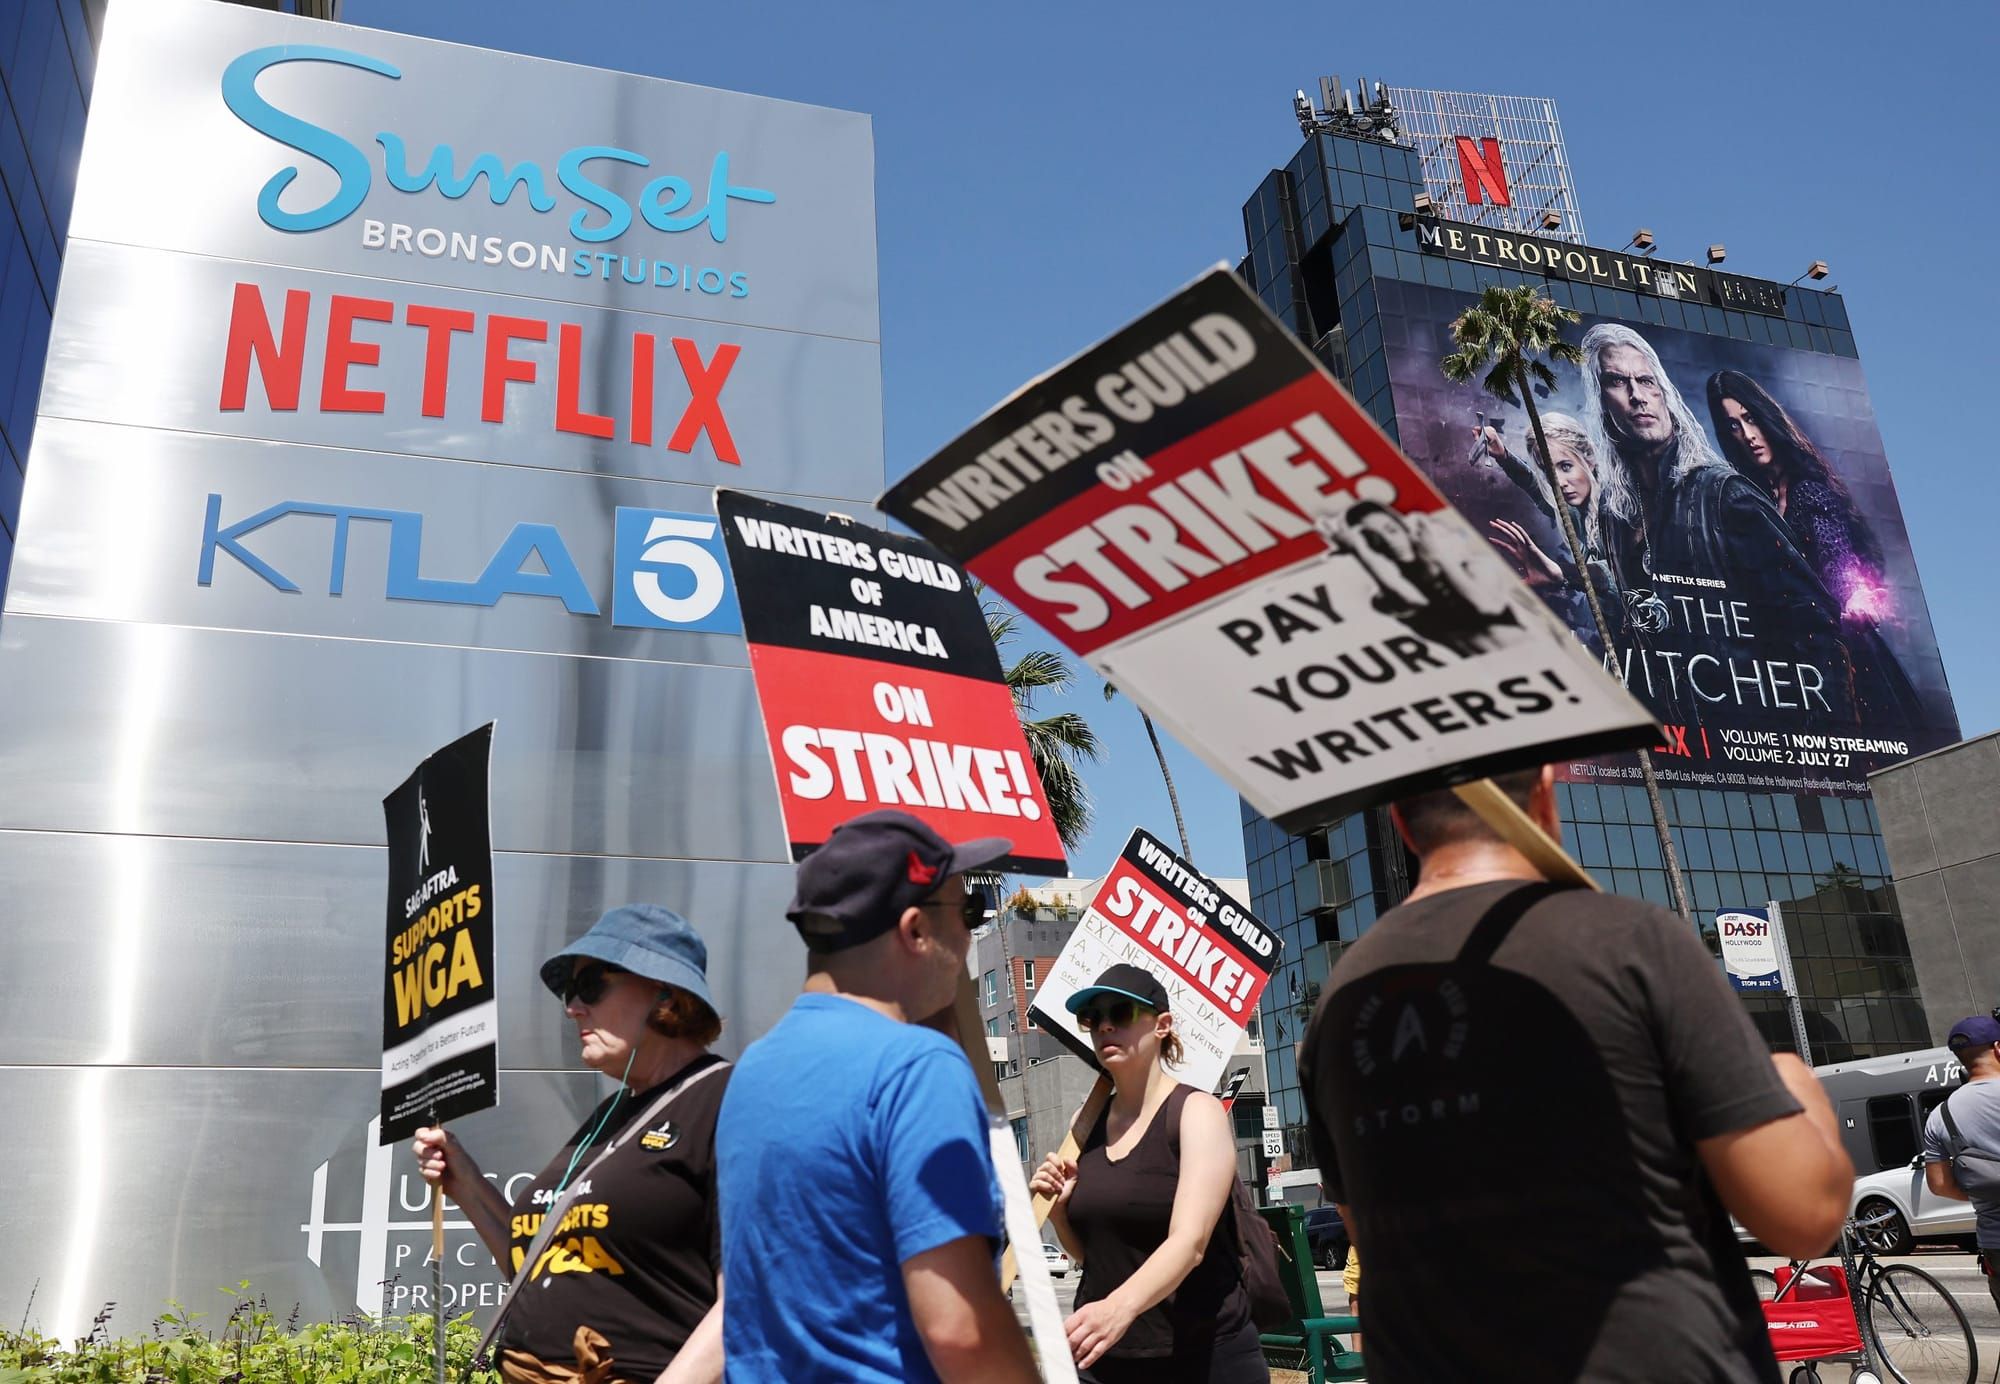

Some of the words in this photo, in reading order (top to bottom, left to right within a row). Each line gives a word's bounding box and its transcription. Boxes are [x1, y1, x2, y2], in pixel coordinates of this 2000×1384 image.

[362, 218, 567, 275] BRONSON
[572, 249, 749, 298] STUDIOS
[1417, 222, 1697, 294] METROPOLITN
[219, 282, 741, 466] NETFLIX
[912, 397, 1115, 533] WRITERS
[1096, 312, 1257, 421] GUILD
[1097, 449, 1153, 491] ON
[1012, 411, 1398, 633] STRIKE!
[197, 493, 600, 616] KTLA
[632, 517, 725, 623] 5
[733, 516, 877, 572] WRITERS
[879, 548, 962, 593] GUILD
[850, 577, 883, 607] OF
[1652, 573, 1659, 582] A
[1659, 574, 1695, 586] NETFLIX
[1696, 578, 1727, 589] SERIES
[810, 604, 949, 659] AMERICA
[1219, 584, 1348, 658] PAY
[1673, 595, 1755, 639] THE
[1251, 624, 1446, 716] YOUR
[873, 681, 934, 728] ON
[1249, 667, 1583, 783] WRITERS!
[1719, 728, 1780, 747] VOLUME
[1783, 733, 1790, 747] 1
[1792, 734, 1829, 750] NOW
[1829, 737, 1909, 755] STREAMING
[1723, 746, 1784, 764] VOLUME
[1786, 751, 1794, 764] 2
[1797, 752, 1829, 767] JULY
[1833, 754, 1850, 768] 27
[782, 724, 1041, 822] STRIKE!
[1570, 763, 1598, 777] NETFLIX
[1599, 766, 1620, 778] located
[1621, 768, 1628, 778] at
[1666, 769, 1679, 781] Blvd
[1680, 770, 1690, 782] Los
[1717, 772, 1727, 783] CA
[1748, 774, 1764, 786] Inside
[1765, 775, 1774, 786] the
[1775, 775, 1803, 790] Hollywood
[1804, 778, 1846, 791] Redevelopment
[1847, 780, 1865, 794] Project
[1137, 837, 1220, 914] WRITERS
[1218, 907, 1274, 957] GUILD
[1186, 906, 1207, 928] ON
[393, 884, 482, 966] SUPPORTS
[1074, 939, 1087, 952] A
[1105, 876, 1256, 1013] STRIKE!
[1724, 922, 1768, 937] DASH
[393, 927, 483, 1028] WGA
[1069, 953, 1091, 976] take
[1197, 1002, 1226, 1033] DAY
[391, 1058, 409, 1072] Acting
[440, 1031, 459, 1048] Better
[460, 1021, 486, 1037] Future
[1190, 1028, 1224, 1060] WRITERS
[1925, 1065, 1938, 1083] A
[1354, 1092, 1480, 1136] STORM
[1267, 1145, 1281, 1154] 30
